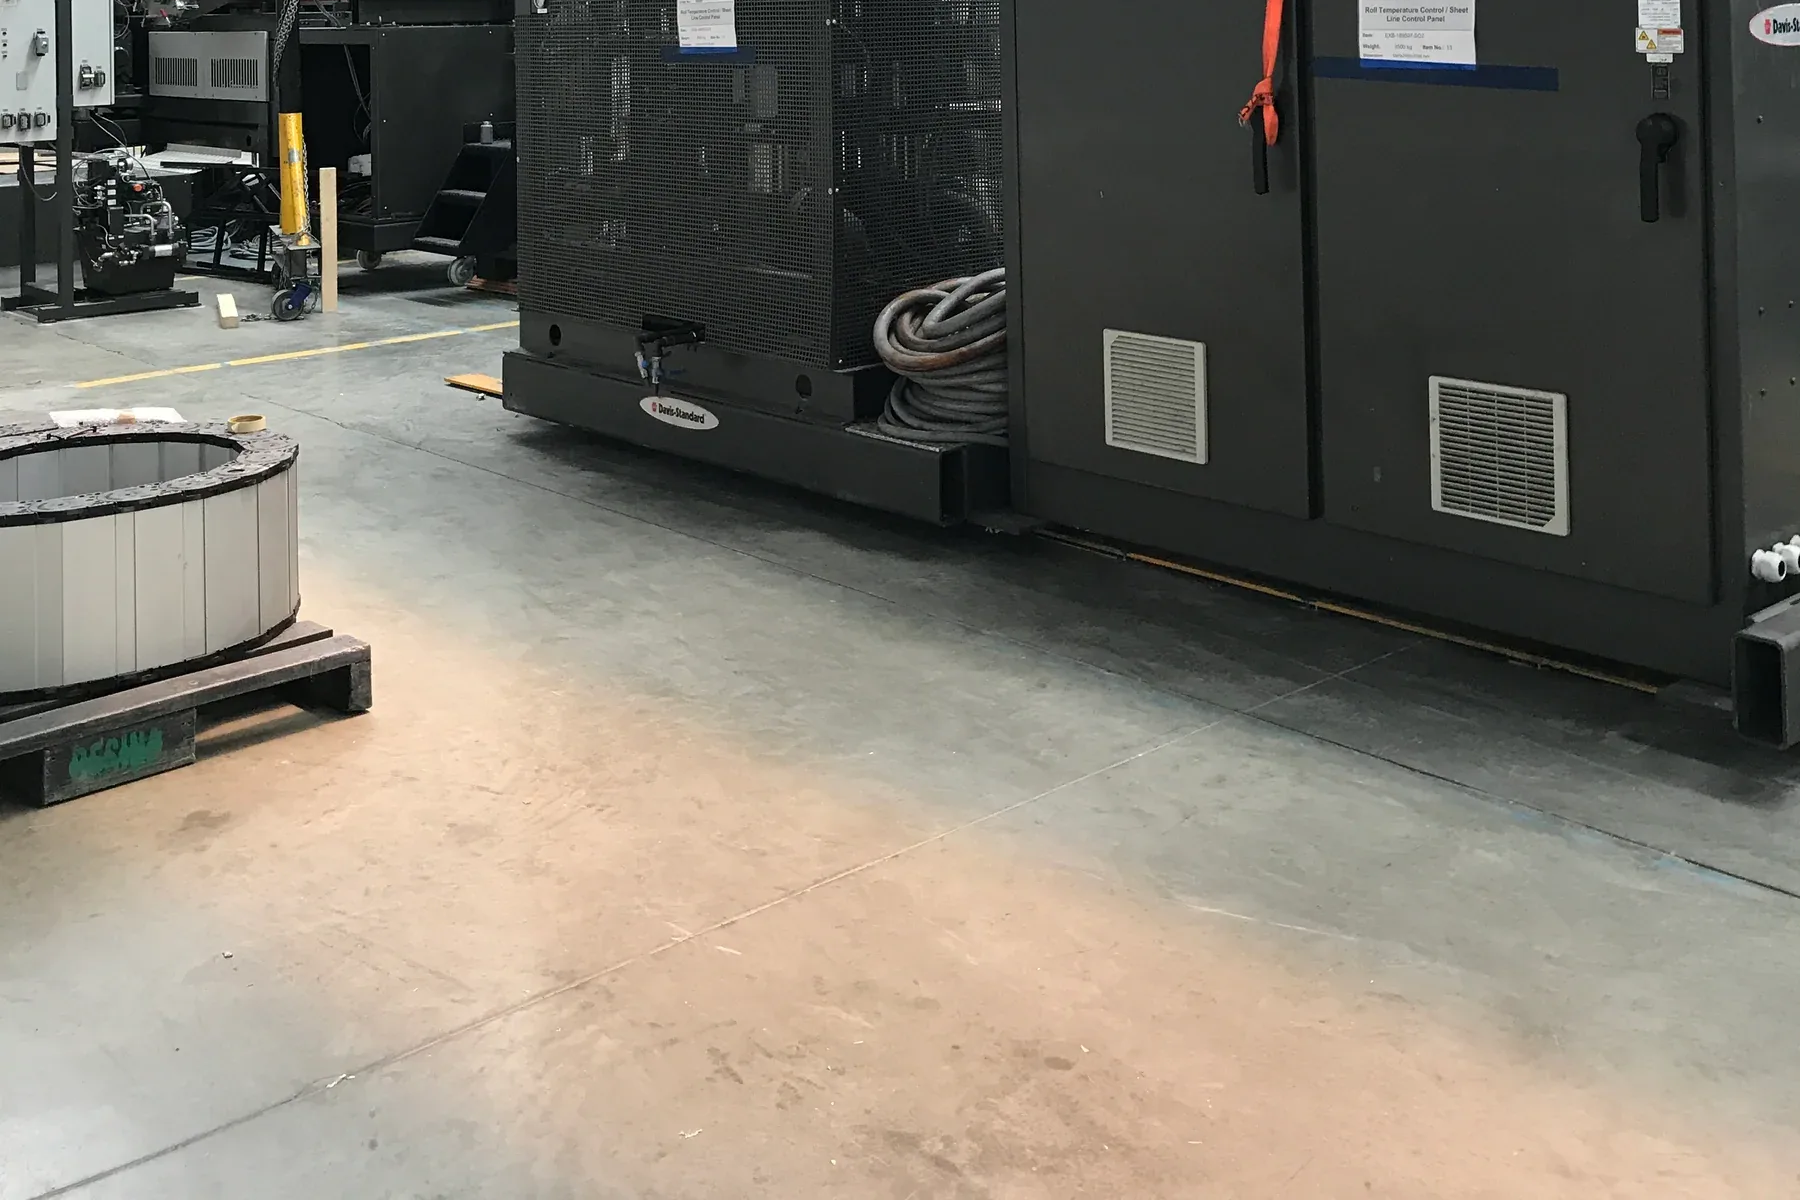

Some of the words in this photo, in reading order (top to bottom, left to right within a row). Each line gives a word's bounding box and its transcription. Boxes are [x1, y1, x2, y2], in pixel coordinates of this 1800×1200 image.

[1365, 6, 1378, 14] Roll
[1378, 6, 1419, 15] Temperature
[1773, 17, 1800, 35] Davis-St
[658, 403, 705, 424] Davis-Standard
